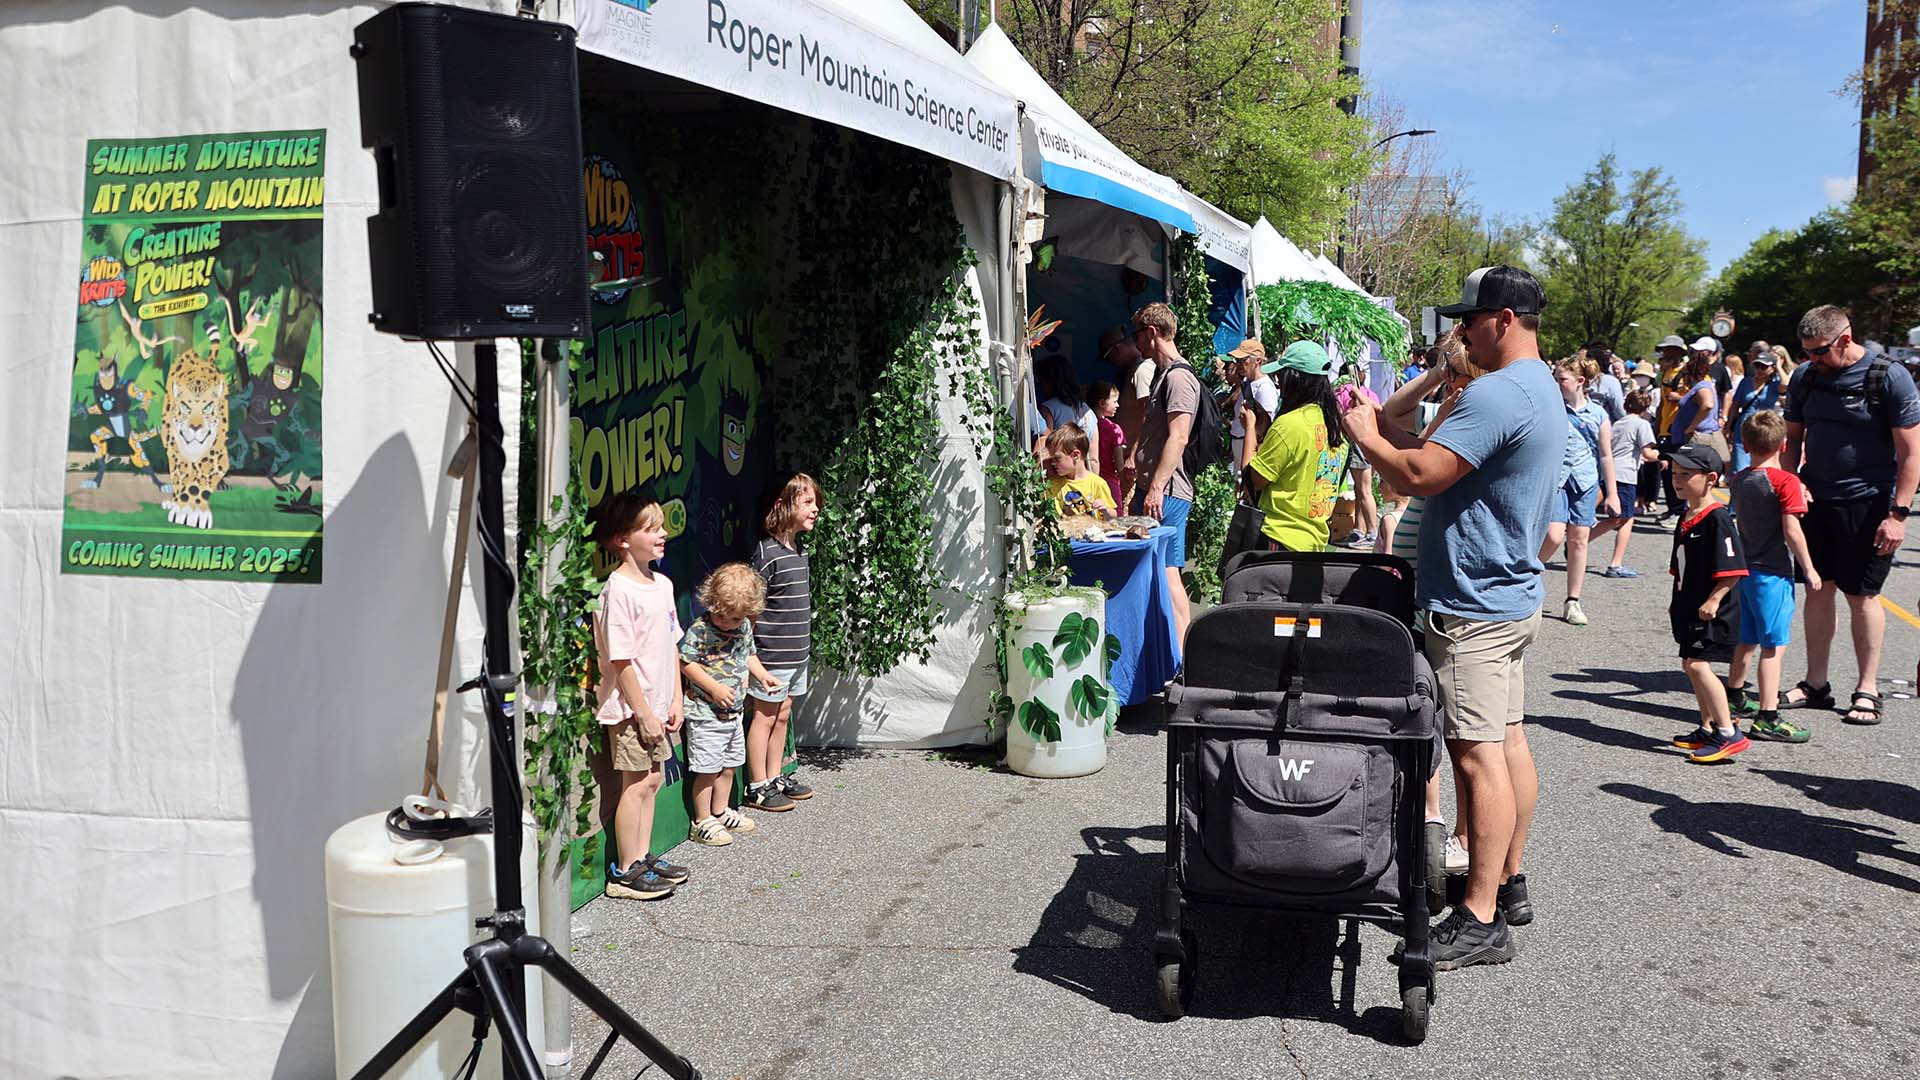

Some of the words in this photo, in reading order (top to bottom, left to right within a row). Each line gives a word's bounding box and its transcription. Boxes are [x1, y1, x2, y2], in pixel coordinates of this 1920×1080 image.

[605, 5, 652, 34] IMAGINE
[707, 0, 793, 72] Roper
[799, 33, 900, 111] Mountain
[904, 79, 964, 135] Science
[967, 106, 1009, 152] Center
[1038, 126, 1070, 154] tivate
[92, 143, 189, 175] SUMMER
[194, 136, 321, 172] ADVENTURE
[91, 183, 127, 214] AT
[128, 180, 200, 213] ROPER
[204, 176, 325, 211] MOUNTAIN
[123, 222, 221, 267] CREATURE
[89, 259, 122, 282] WILD
[133, 256, 215, 303] POWER!
[79, 278, 127, 305] KRATTS
[153, 304, 166, 314] THE
[167, 298, 196, 312] EXHIBIT
[68, 540, 144, 568] COMING
[149, 543, 236, 572] SUMMER
[239, 546, 314, 574] 2025!
[1724, 536, 1735, 557] 1
[1278, 758, 1315, 781] WF
